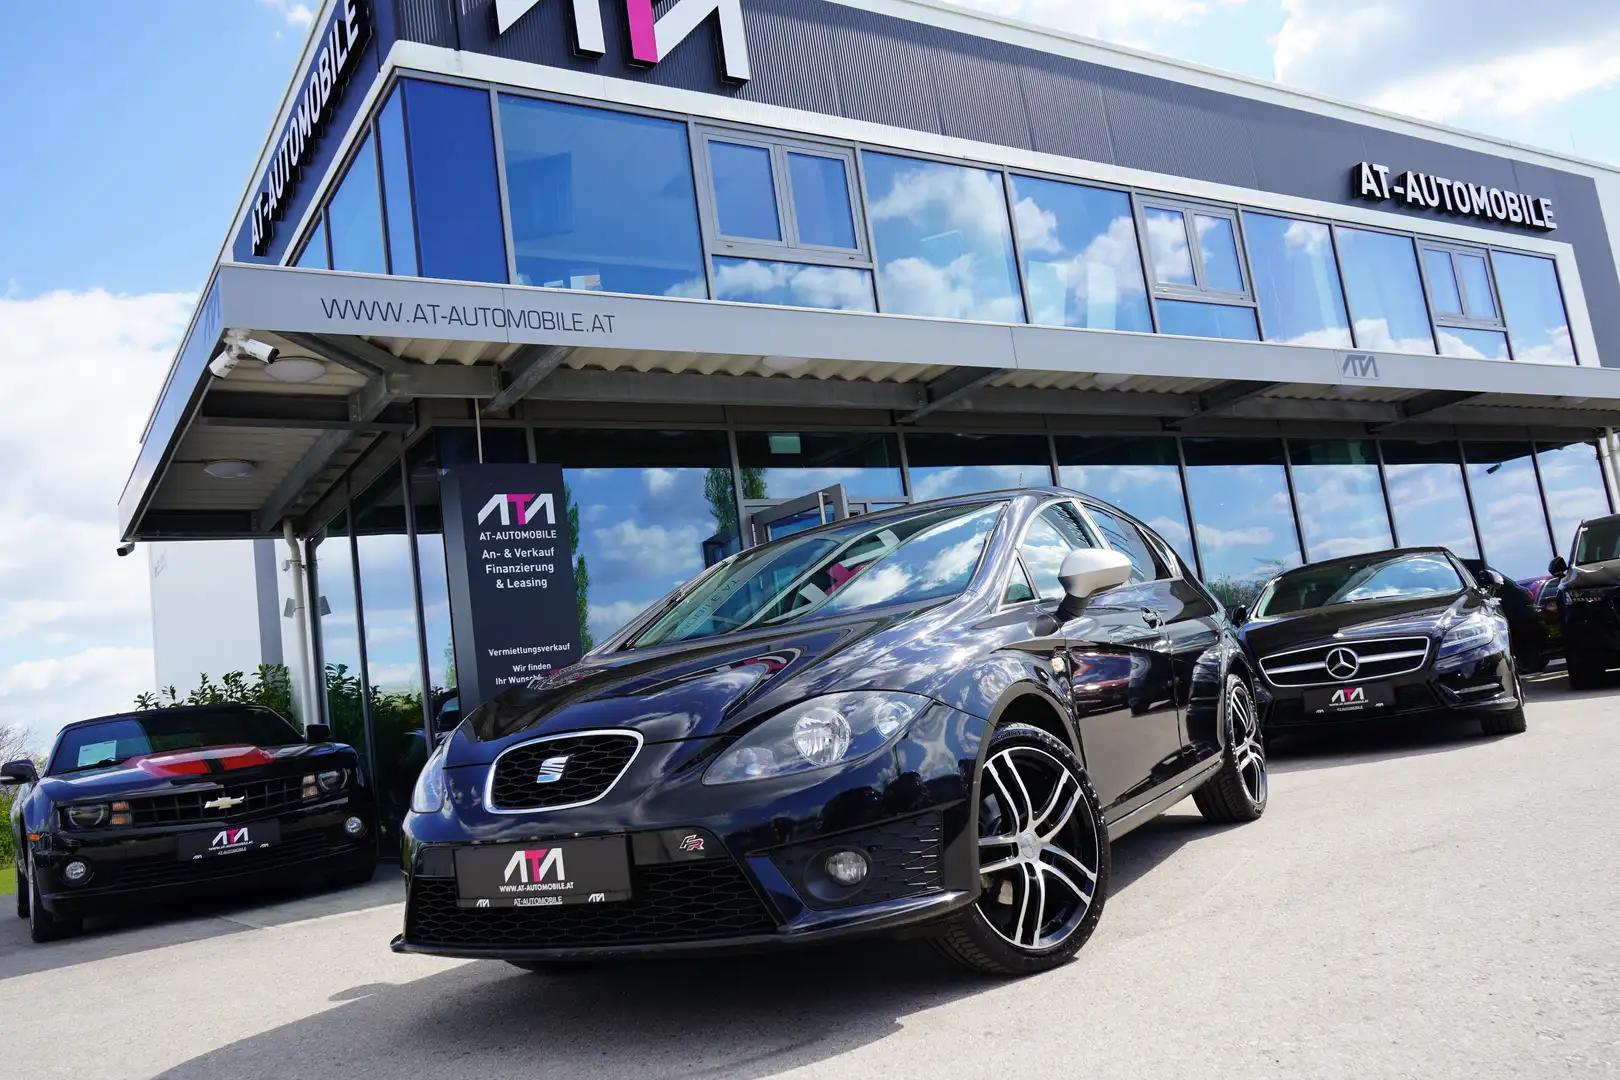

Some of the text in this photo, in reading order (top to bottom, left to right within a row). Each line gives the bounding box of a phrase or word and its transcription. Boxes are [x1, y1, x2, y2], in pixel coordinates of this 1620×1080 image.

[252, 0, 359, 256] AT-AUTOMOBILE
[1361, 161, 1557, 230] AT-AUTOMOBILE
[320, 297, 616, 334] WWW.AT-AUTOMOBILE.AT
[477, 493, 556, 526] ATA
[479, 529, 557, 541] AT-AUTOMOBILE
[482, 546, 555, 559] An- & Verkauf
[485, 562, 554, 574] Finanzierung
[496, 577, 548, 589] & Leasing
[488, 643, 571, 657] Vermietlungsverkauf
[527, 662, 552, 671] finden
[495, 677, 506, 686] Ihr
[504, 848, 566, 883] ATA
[499, 882, 574, 893] WWW.AT-AUTOMOBILE.AT
[513, 896, 563, 907] AT-AUTOMOBILE
